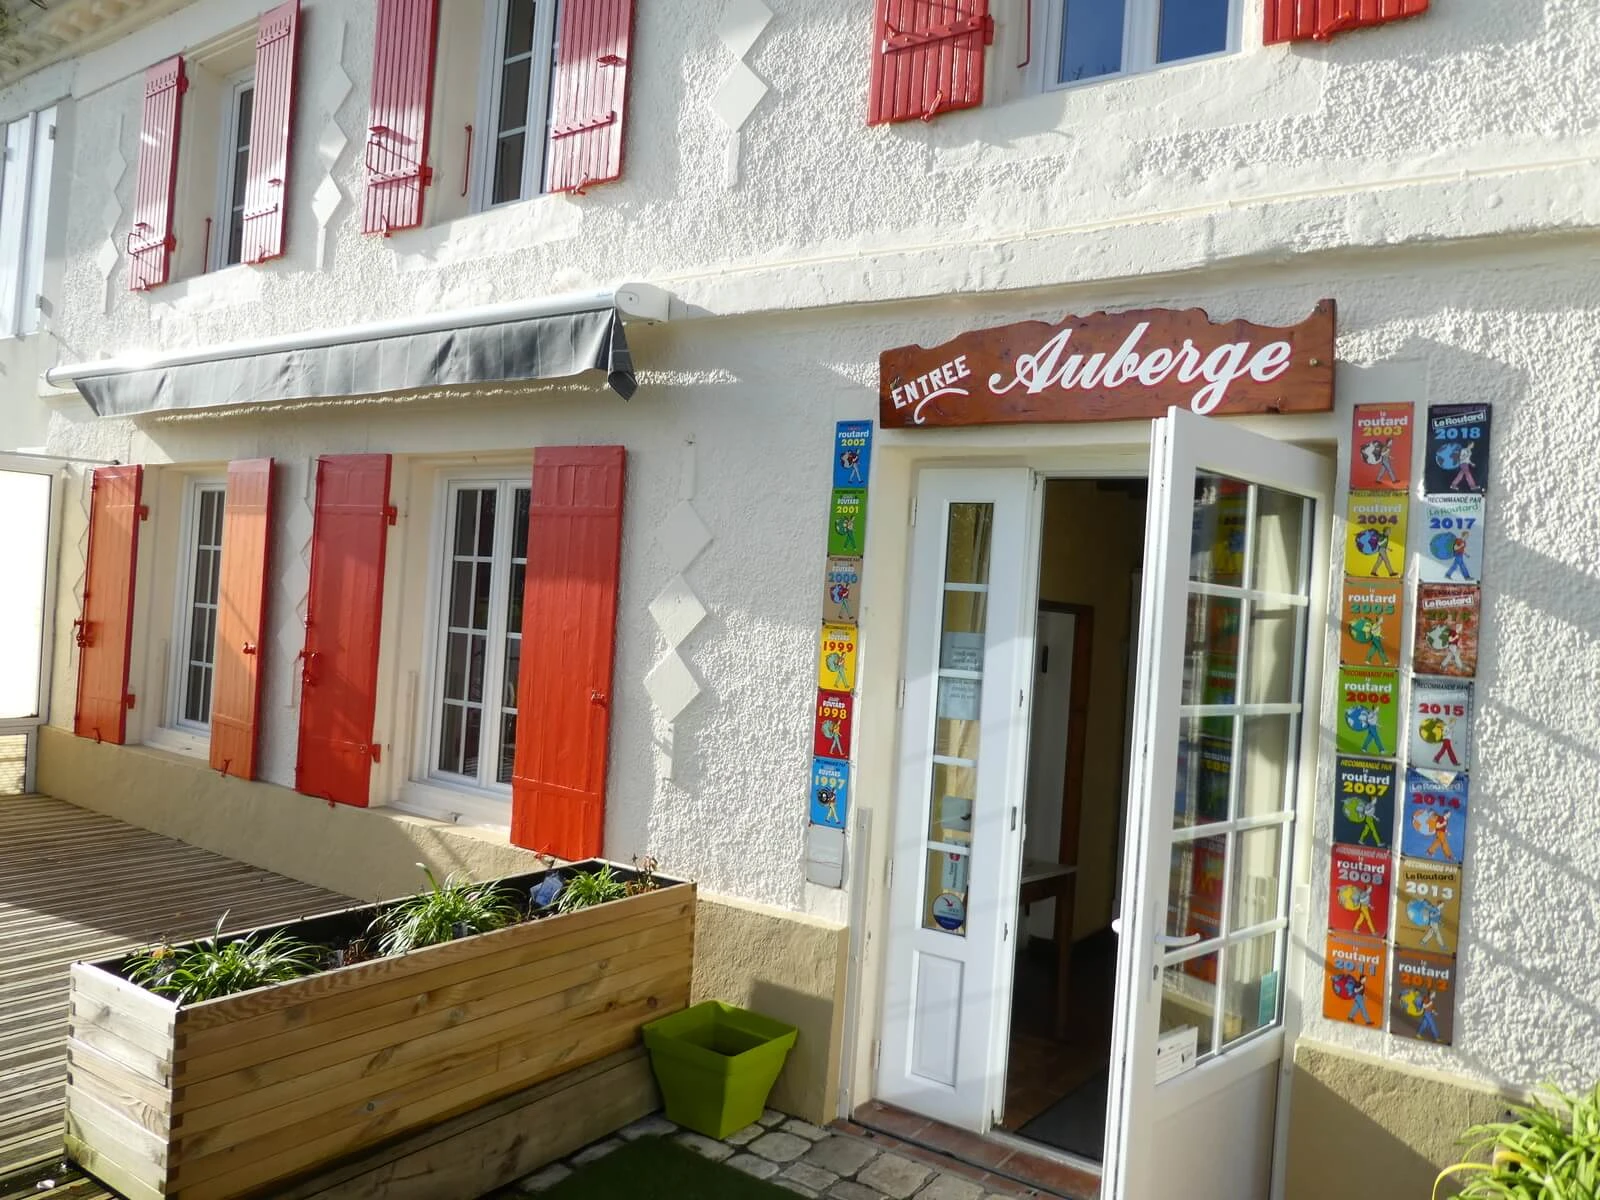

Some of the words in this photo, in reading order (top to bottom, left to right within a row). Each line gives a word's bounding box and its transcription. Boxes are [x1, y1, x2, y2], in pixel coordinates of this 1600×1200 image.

[988, 322, 1291, 414] Auberge
[891, 354, 972, 409] ENTREE
[1358, 416, 1408, 426] routard
[838, 430, 869, 438] routard
[1363, 426, 1402, 436] 2003
[1435, 427, 1481, 439] 2018
[841, 438, 865, 447] 2002
[836, 505, 860, 514] 2001
[1353, 503, 1402, 513] routard
[1358, 515, 1398, 525] 2004
[1430, 517, 1476, 529] 2017
[1348, 594, 1396, 604] routard
[823, 640, 853, 653] 1999
[1345, 682, 1392, 692] routard
[1346, 691, 1391, 704] 2006
[819, 705, 847, 720] 1998
[1419, 703, 1464, 716] 2015
[815, 775, 846, 789] 1997
[1342, 773, 1390, 785] routard
[1343, 781, 1389, 796] 2007
[1337, 860, 1385, 874] routard
[1338, 869, 1383, 885] 2008
[1406, 881, 1453, 900] 2013
[1332, 949, 1379, 965] routard
[1335, 959, 1376, 976] 2011
[1399, 962, 1449, 979] routard
